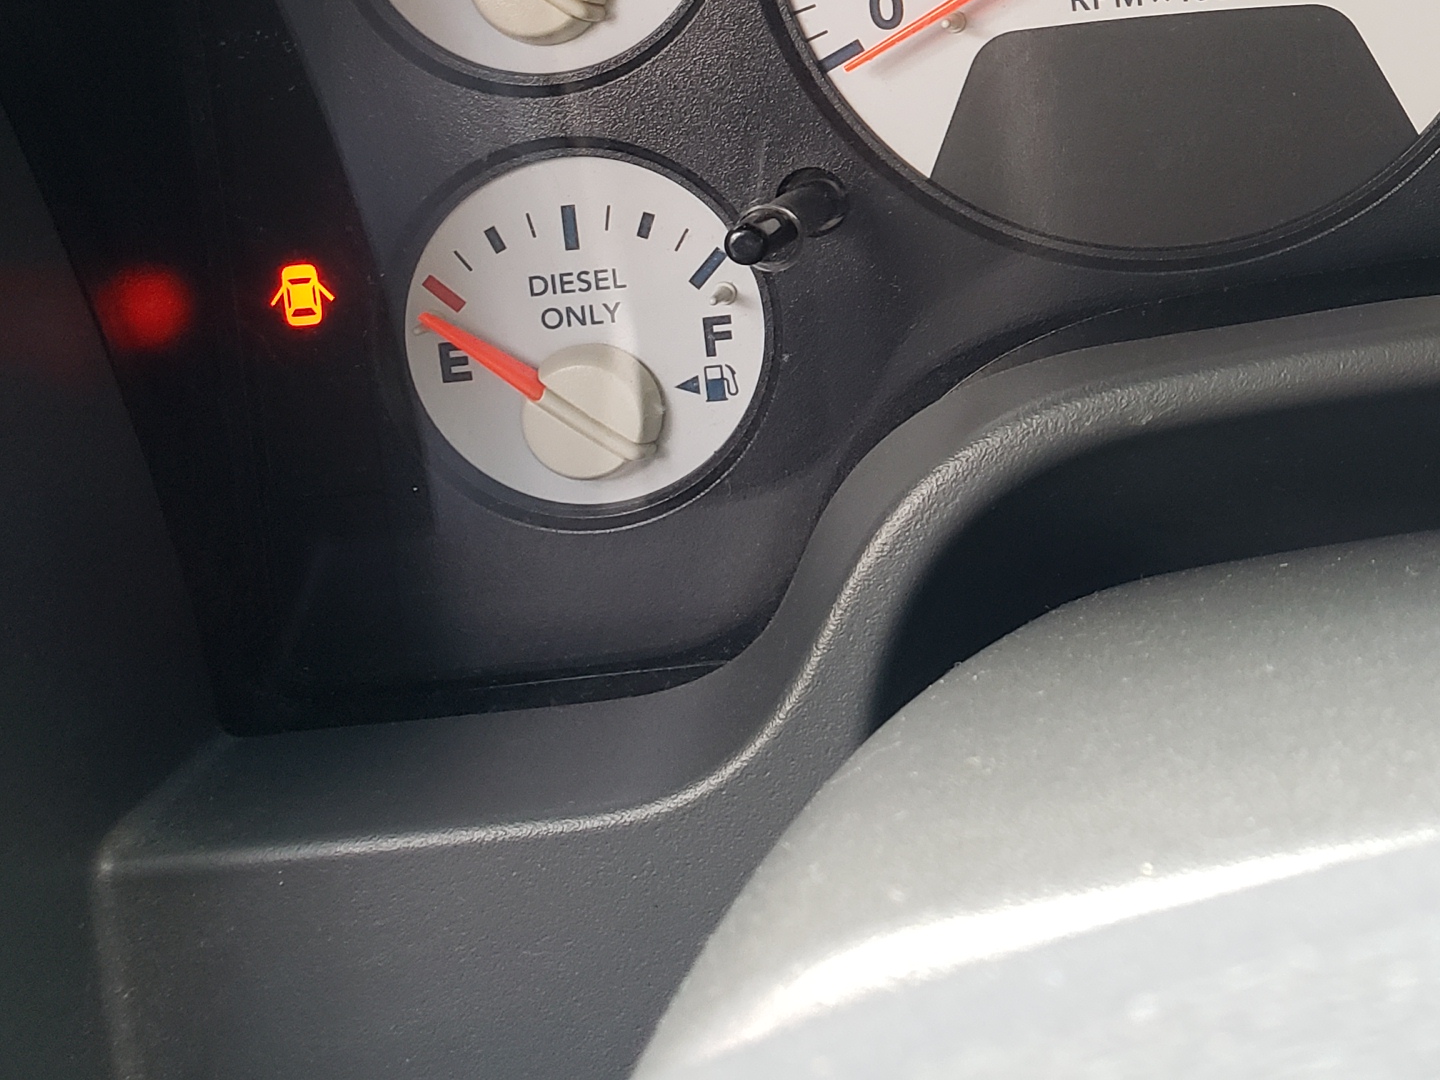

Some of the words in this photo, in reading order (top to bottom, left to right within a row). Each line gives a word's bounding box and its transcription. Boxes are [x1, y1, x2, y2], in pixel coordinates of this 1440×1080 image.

[529, 268, 627, 297] DIESEL
[540, 302, 621, 329] ONLY
[703, 315, 732, 357] F
[438, 342, 473, 383] E
